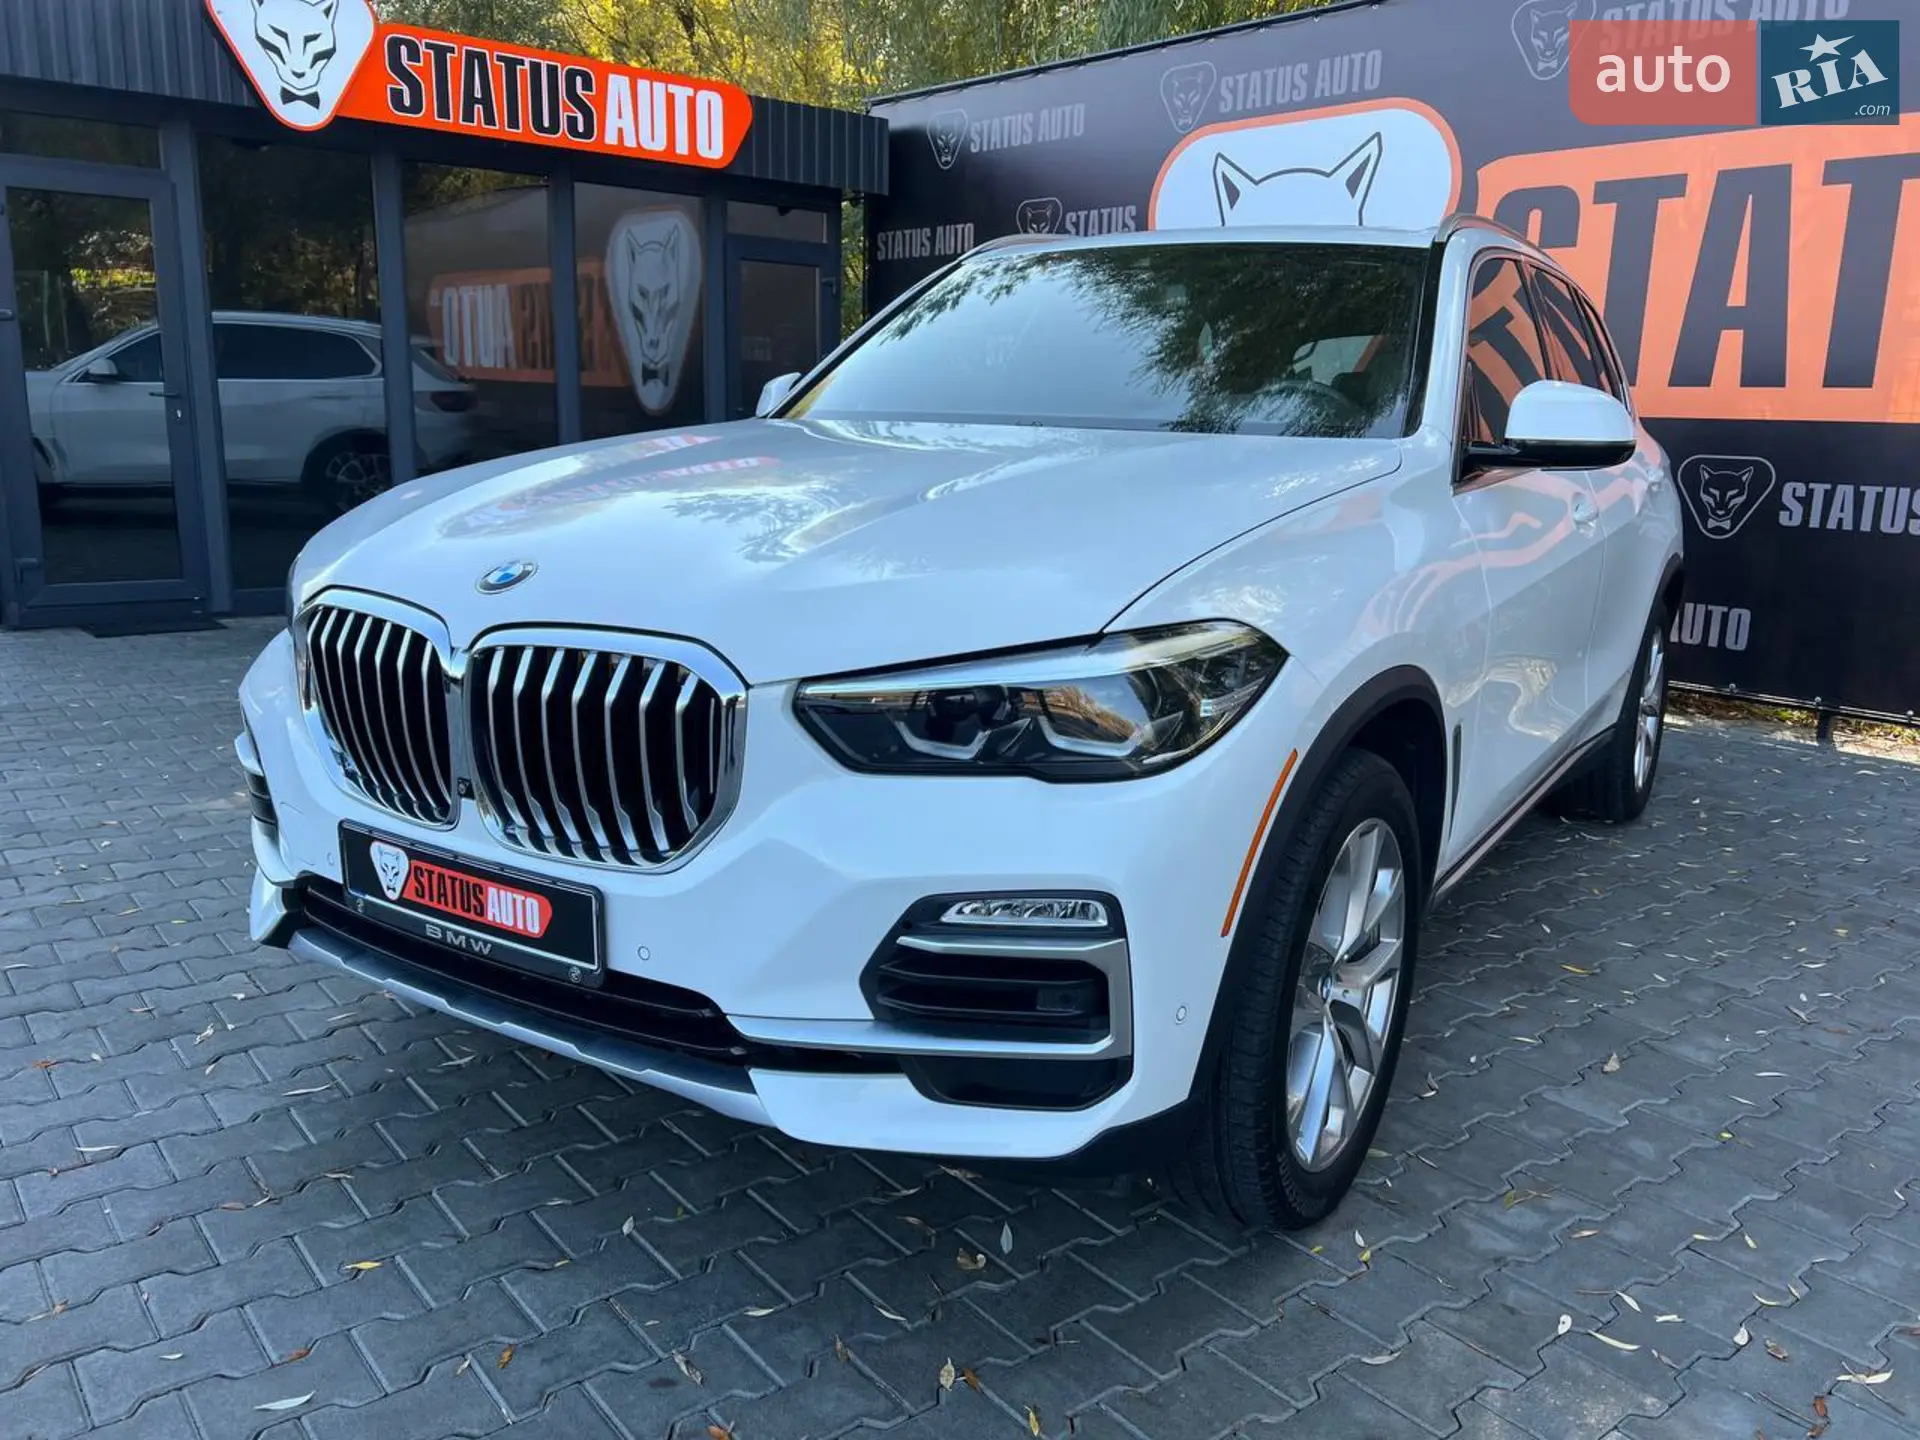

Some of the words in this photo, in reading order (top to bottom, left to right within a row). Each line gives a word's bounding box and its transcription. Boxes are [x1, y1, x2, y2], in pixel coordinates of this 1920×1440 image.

[384, 33, 597, 143] STATUS
[604, 73, 724, 160] AUTO
[1219, 62, 1309, 113] STATUS
[1314, 49, 1383, 98] AUTO
[970, 112, 1034, 153] STATUS
[1037, 102, 1086, 143] AUTO
[876, 227, 931, 262] STATUS
[935, 222, 975, 256] AUTO
[1065, 205, 1138, 237] STATUS
[413, 865, 485, 918] STATUS
[486, 886, 542, 936] AUTO
[425, 923, 493, 956] BMW
